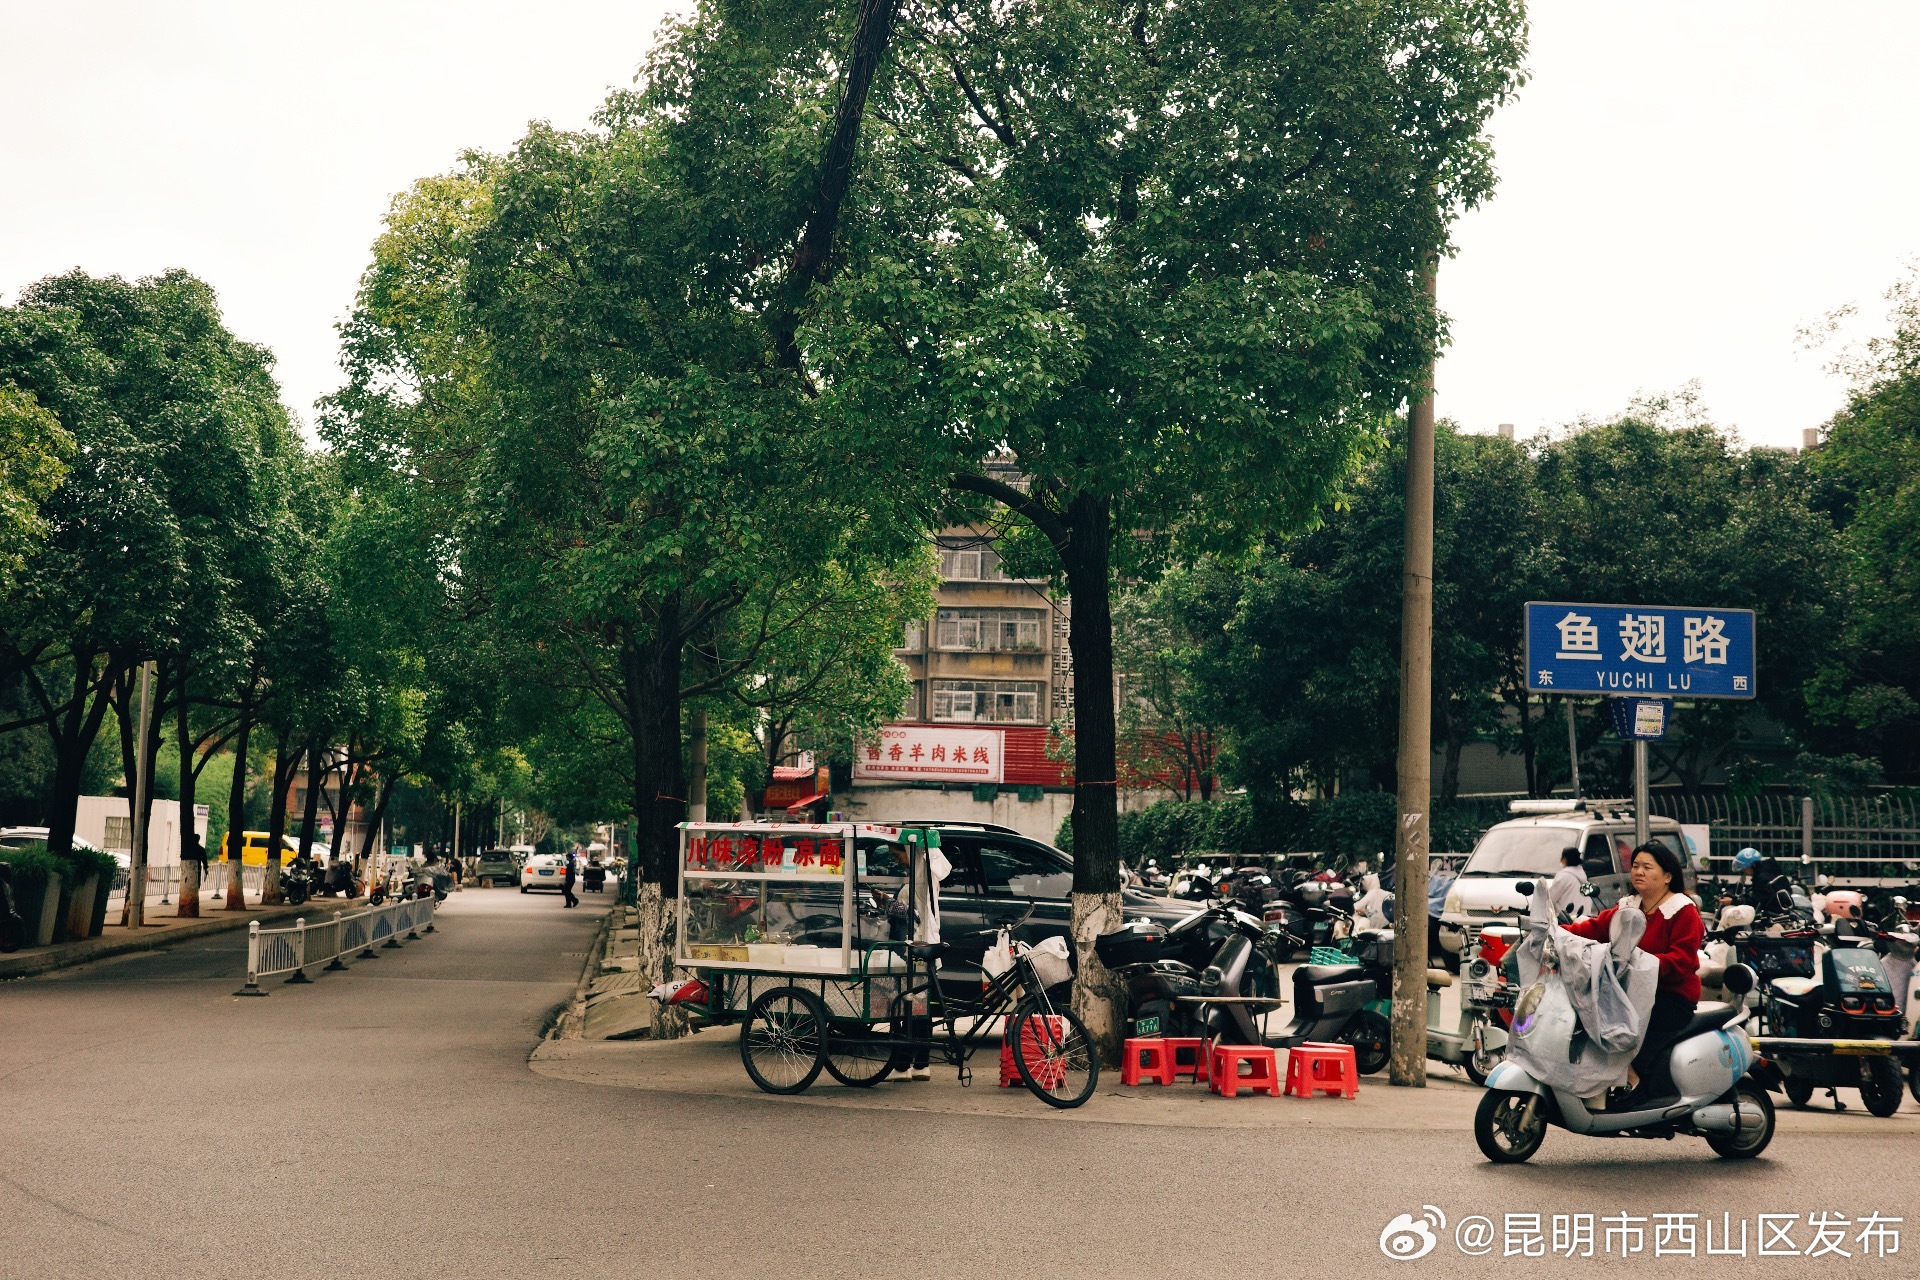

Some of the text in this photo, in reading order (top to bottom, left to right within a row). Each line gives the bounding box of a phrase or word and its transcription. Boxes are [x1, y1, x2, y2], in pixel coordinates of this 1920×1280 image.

[1555, 611, 1731, 665] 鱼翅路
[1538, 669, 1553, 686] 东
[1596, 671, 1691, 690] YUCHI LU
[1733, 675, 1748, 691] 西
